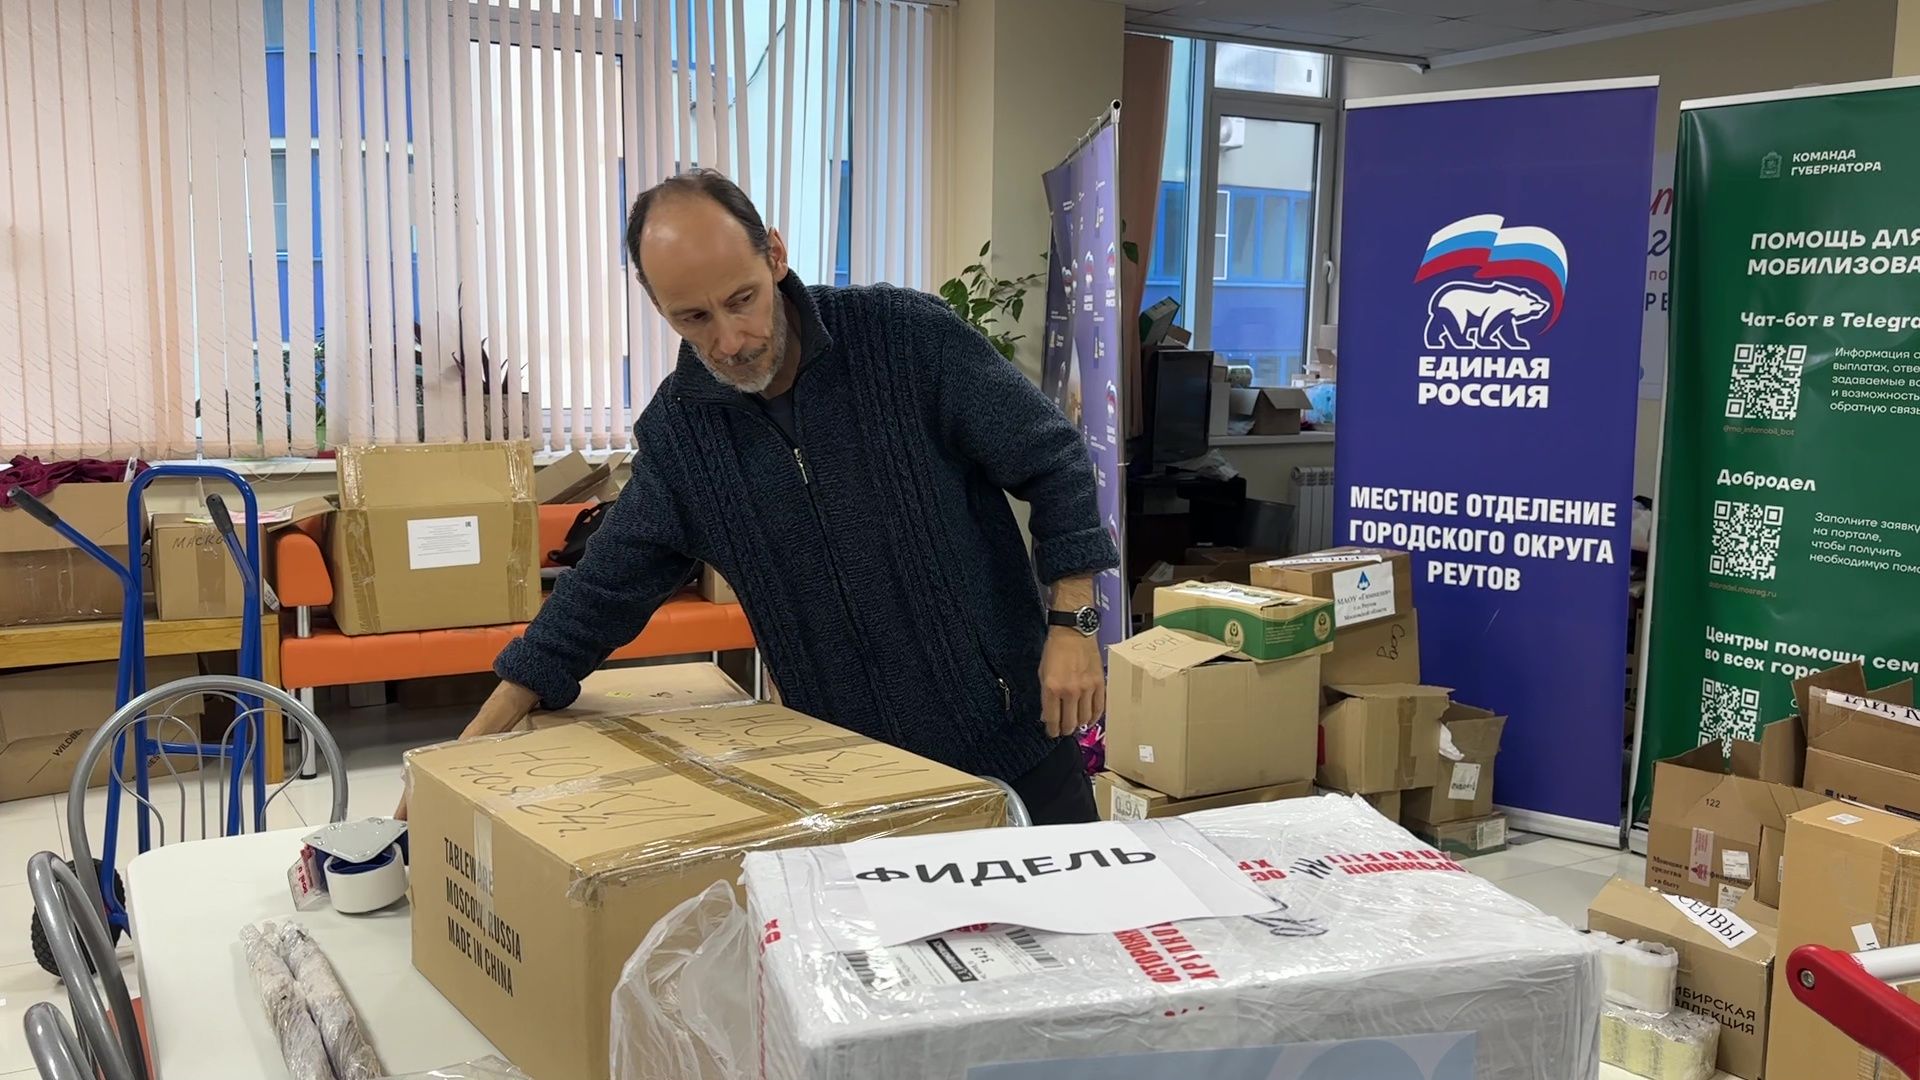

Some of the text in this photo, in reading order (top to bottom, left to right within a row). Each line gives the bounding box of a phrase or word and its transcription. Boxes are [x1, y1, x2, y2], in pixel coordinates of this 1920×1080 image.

[1792, 149, 1856, 162] КОМАНДА
[1791, 161, 1882, 177] ГУБЕРНАТОРА
[1751, 228, 1920, 250] ПОМОЩЬ ДЛЯ
[1747, 255, 1920, 276] МОБИЛИЗОВА
[1740, 311, 1920, 332] Чат-бот в Telegra
[1834, 347, 1910, 360] Информация
[1418, 356, 1550, 380] ЕДИНАЯ
[1832, 362, 1890, 374] выплатах,
[1831, 376, 1906, 388] задаваемые
[1418, 382, 1549, 408] РОССИЯ
[1831, 389, 1920, 402] и возможность
[1829, 401, 1887, 415] обратную
[1716, 468, 1816, 492] Добродел
[1350, 486, 1617, 527] МЕСТНОЕ ОТДЕЛЕНИЕ
[1814, 511, 1878, 528] Заполните
[1350, 519, 1614, 564] ГОРОДСКОГО ОКРУГА
[1813, 526, 1882, 543] на портале,
[1811, 540, 1902, 559] чтобы получить
[1809, 552, 1890, 572] необходимую
[1427, 560, 1521, 592] РЕУТОВ
[1705, 648, 1720, 661] во
[1723, 653, 1765, 672] всех
[1706, 625, 1920, 674] Центры помощи сем
[1705, 798, 1721, 809] 122
[443, 836, 495, 898] TABLEWARE
[855, 847, 1158, 887] ФИДЕЛЬ
[445, 876, 522, 964] MOSCOW, RUSSIA
[447, 915, 514, 998] MADE IN CHINA
